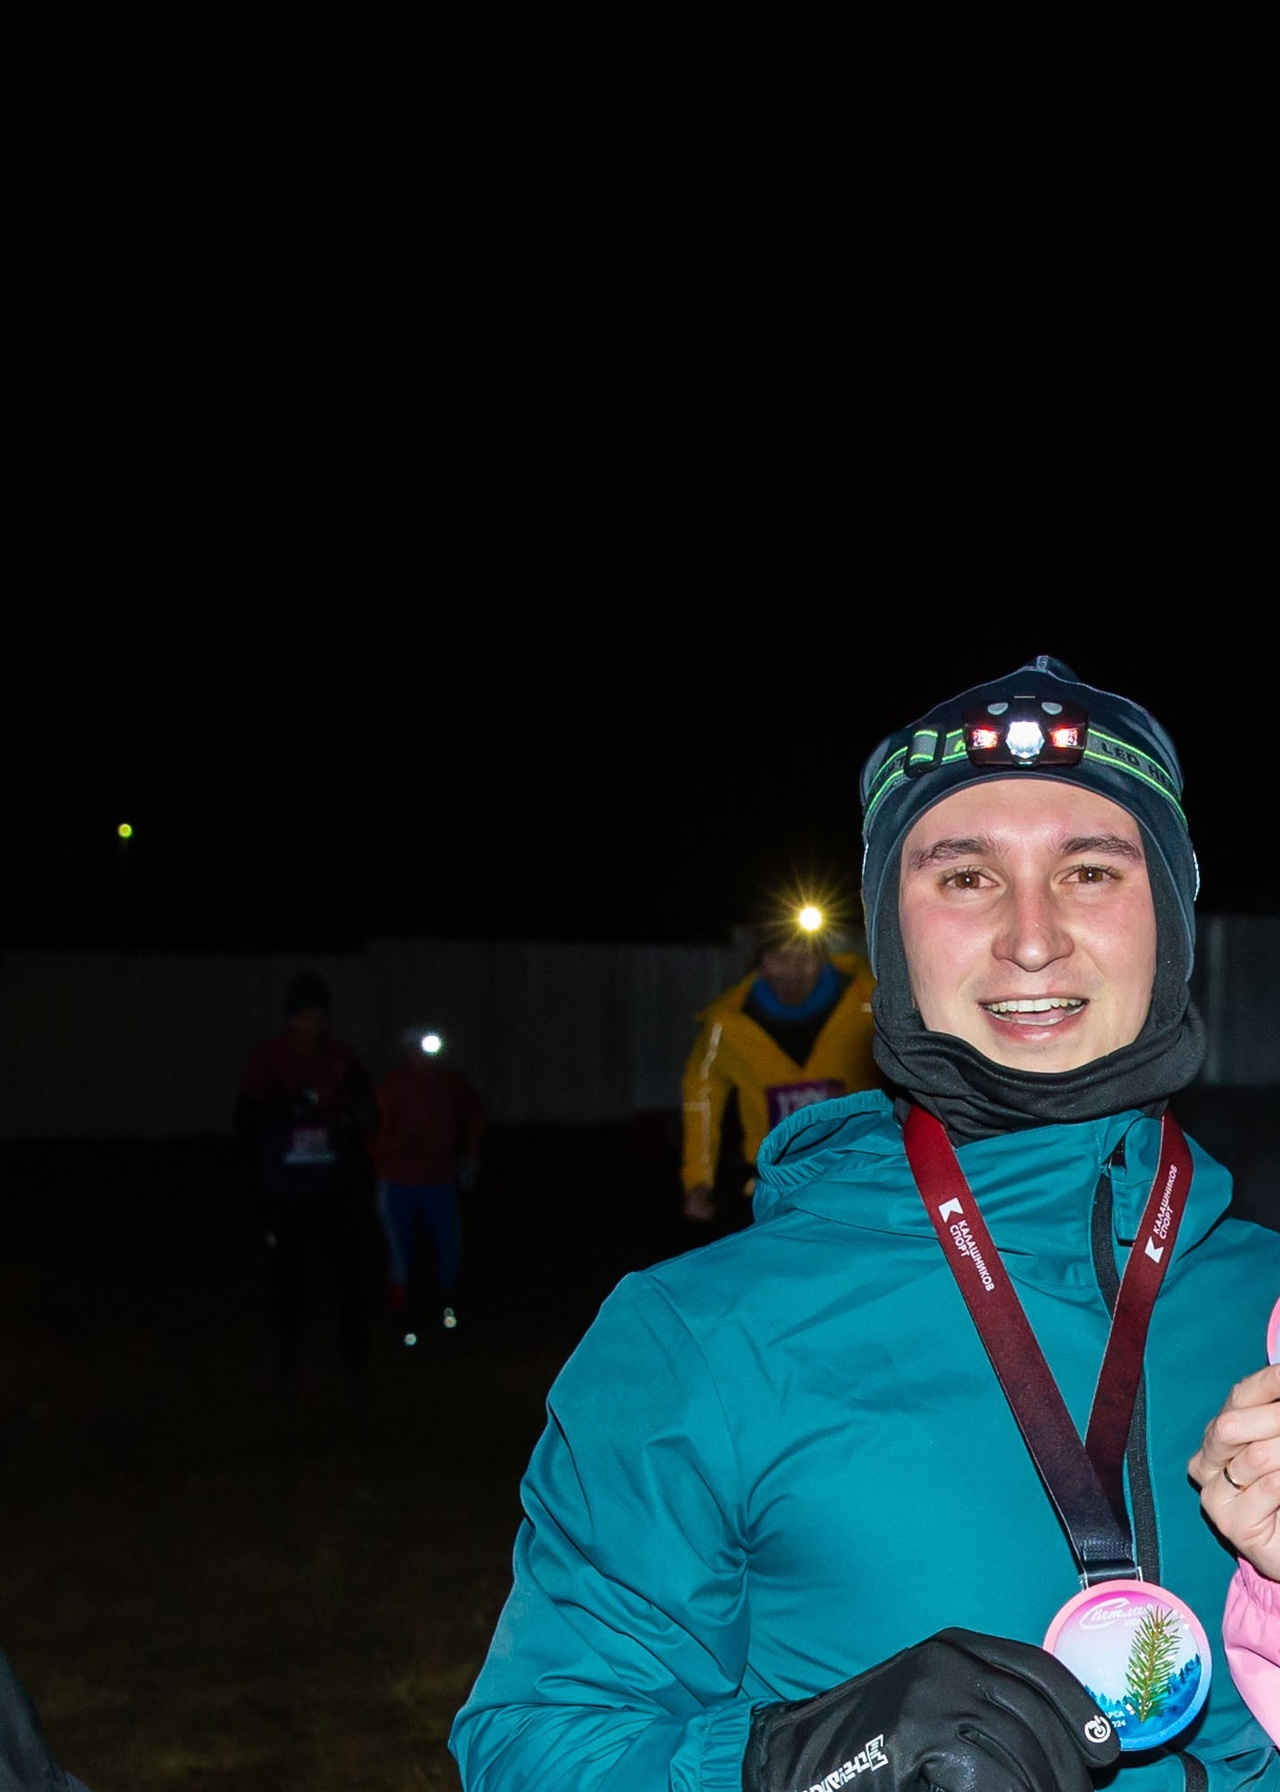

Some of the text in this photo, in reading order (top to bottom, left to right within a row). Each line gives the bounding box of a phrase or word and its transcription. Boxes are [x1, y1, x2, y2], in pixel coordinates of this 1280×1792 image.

[1101, 741, 1141, 768] LED
[1153, 1165, 1178, 1234] КАЛАШНИКОВ
[1159, 1207, 1174, 1239] СПОРТ
[949, 1224, 971, 1257] СПОРТ
[957, 1220, 995, 1292] КАЛАШНИКОВ
